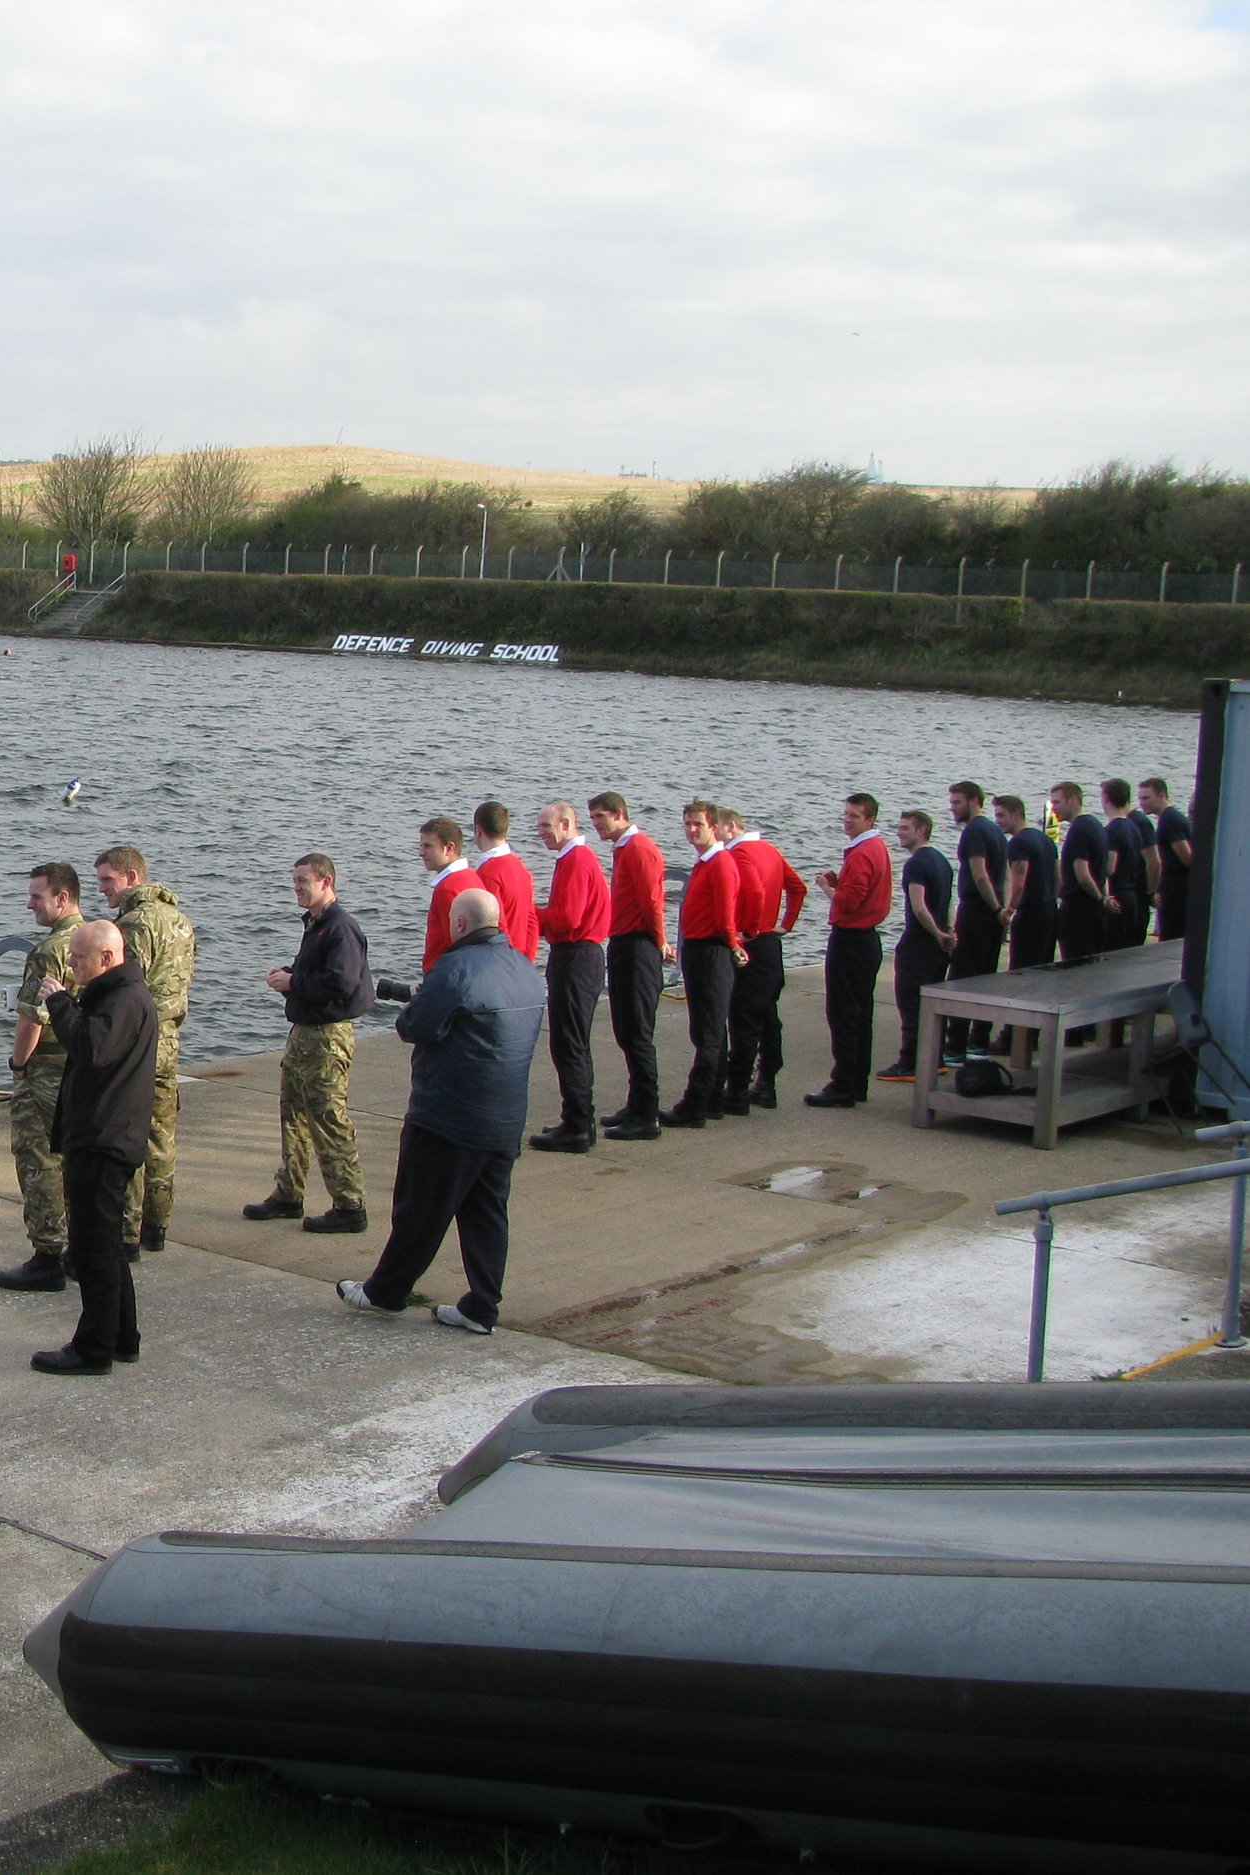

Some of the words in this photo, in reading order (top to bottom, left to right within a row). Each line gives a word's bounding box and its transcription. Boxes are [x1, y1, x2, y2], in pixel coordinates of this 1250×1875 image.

[332, 635, 414, 653] DEFENCE
[421, 640, 484, 657] DIVING
[490, 643, 559, 662] SCHOOL
